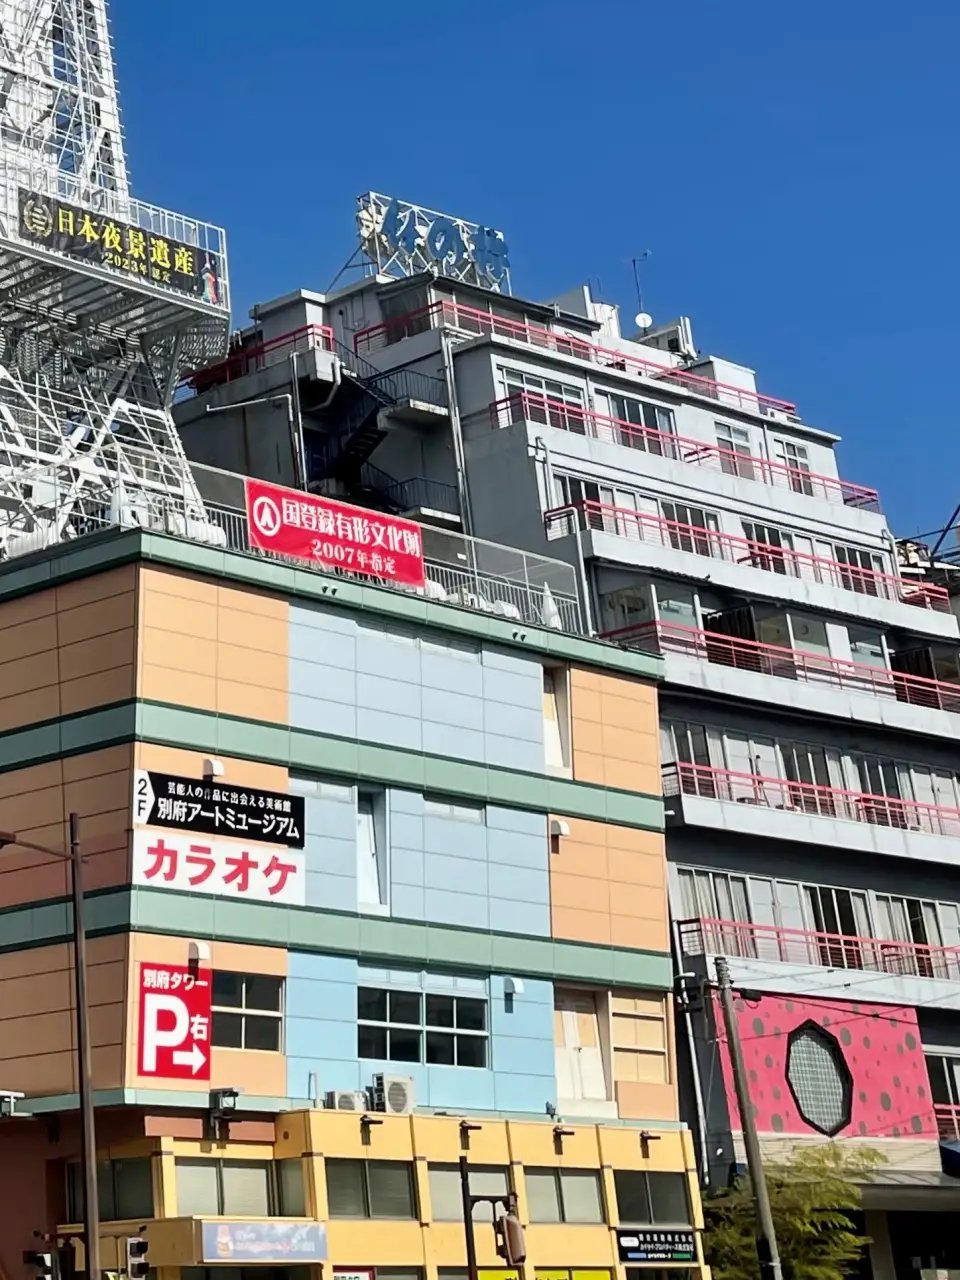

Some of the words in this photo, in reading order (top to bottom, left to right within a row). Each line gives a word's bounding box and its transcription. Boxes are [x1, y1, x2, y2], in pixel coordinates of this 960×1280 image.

[57, 207, 194, 277] 日本夜景遺産
[281, 497, 421, 558] 国登録有形文化財
[311, 538, 396, 575] 2007年指定
[157, 797, 300, 839] 別府アートミュージアム
[167, 781, 292, 813] 芸能人の作品に出会える美術館
[143, 838, 297, 895] カラオケ
[143, 968, 208, 991] 別府タワー
[143, 992, 190, 1072] P
[190, 1014, 209, 1041] 右
